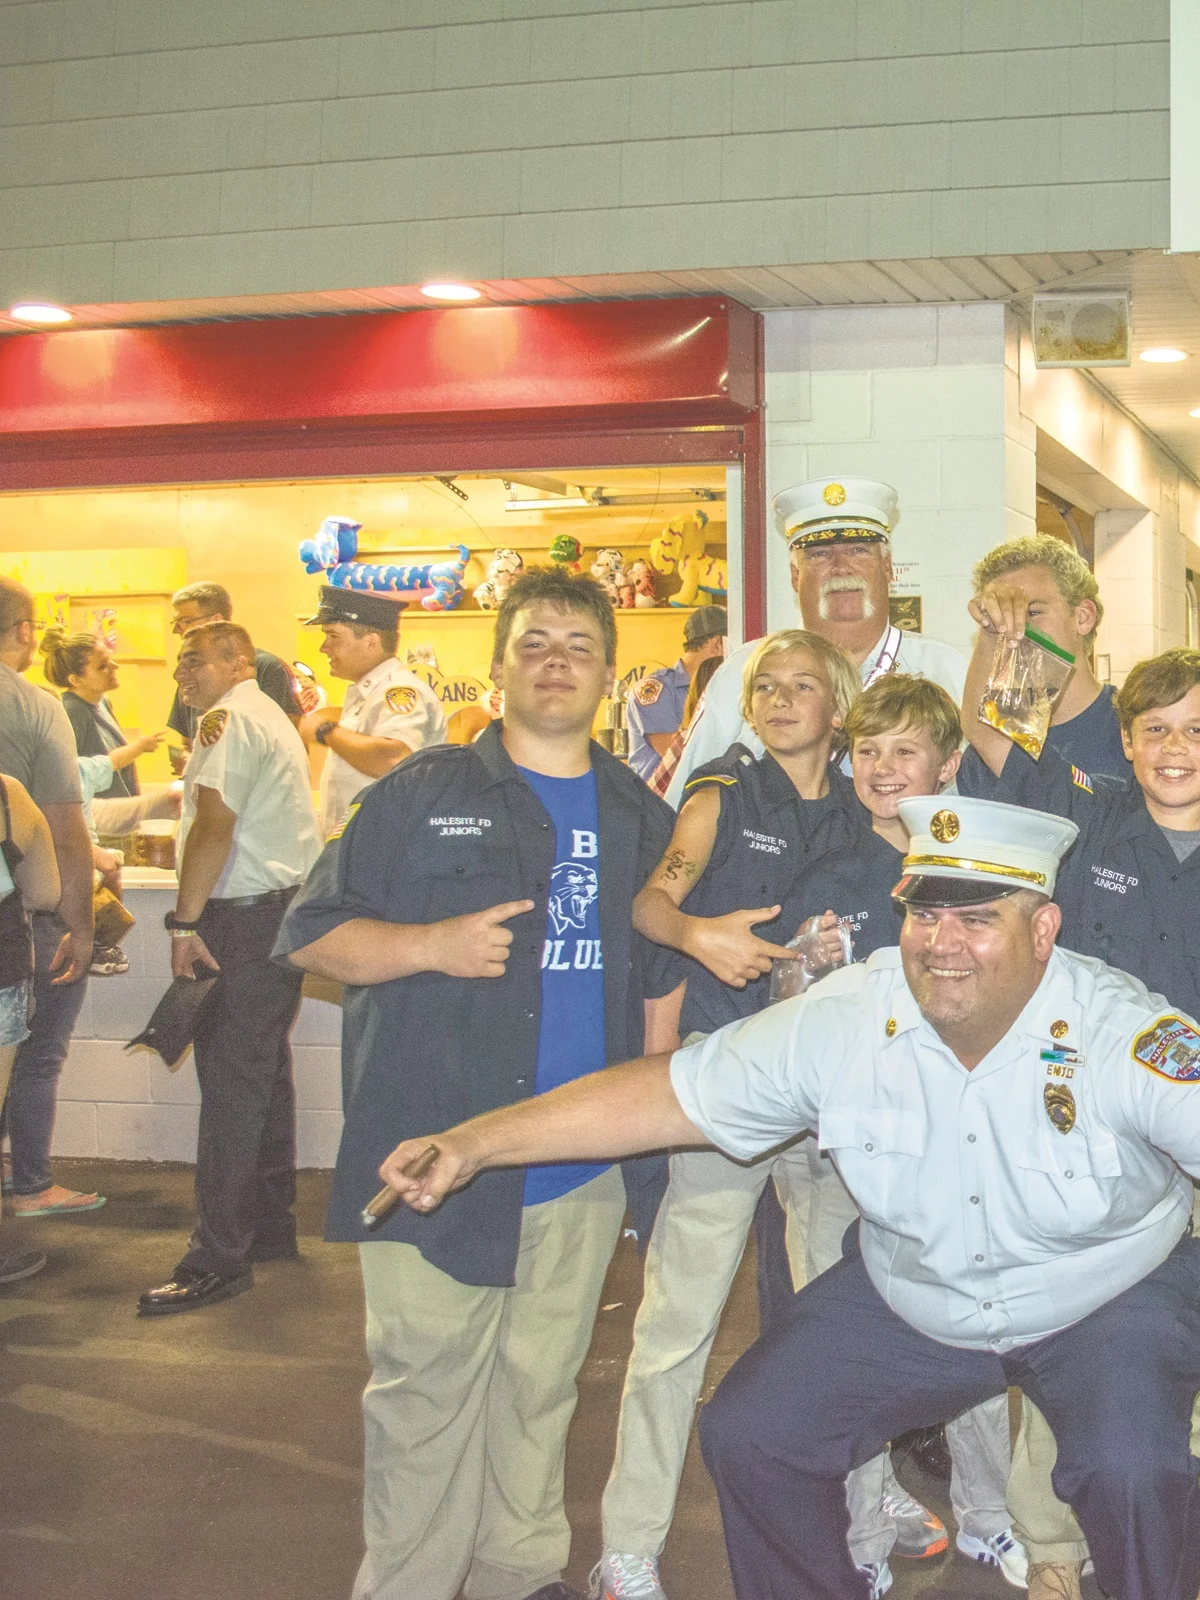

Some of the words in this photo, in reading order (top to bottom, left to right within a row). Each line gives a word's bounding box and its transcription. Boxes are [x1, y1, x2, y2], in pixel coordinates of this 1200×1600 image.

[430, 816, 476, 826] HALESITE
[478, 818, 492, 827] FD
[439, 826, 482, 836] JUNIORS
[743, 828, 777, 845] HALESITE
[778, 838, 788, 848] FD
[749, 841, 781, 855] JUNIORS
[1090, 863, 1126, 883] HALESITE
[1126, 876, 1139, 886] FD
[1094, 876, 1127, 894] JUNIORS
[857, 911, 869, 921] FD
[1151, 1029, 1185, 1061] HALESITE
